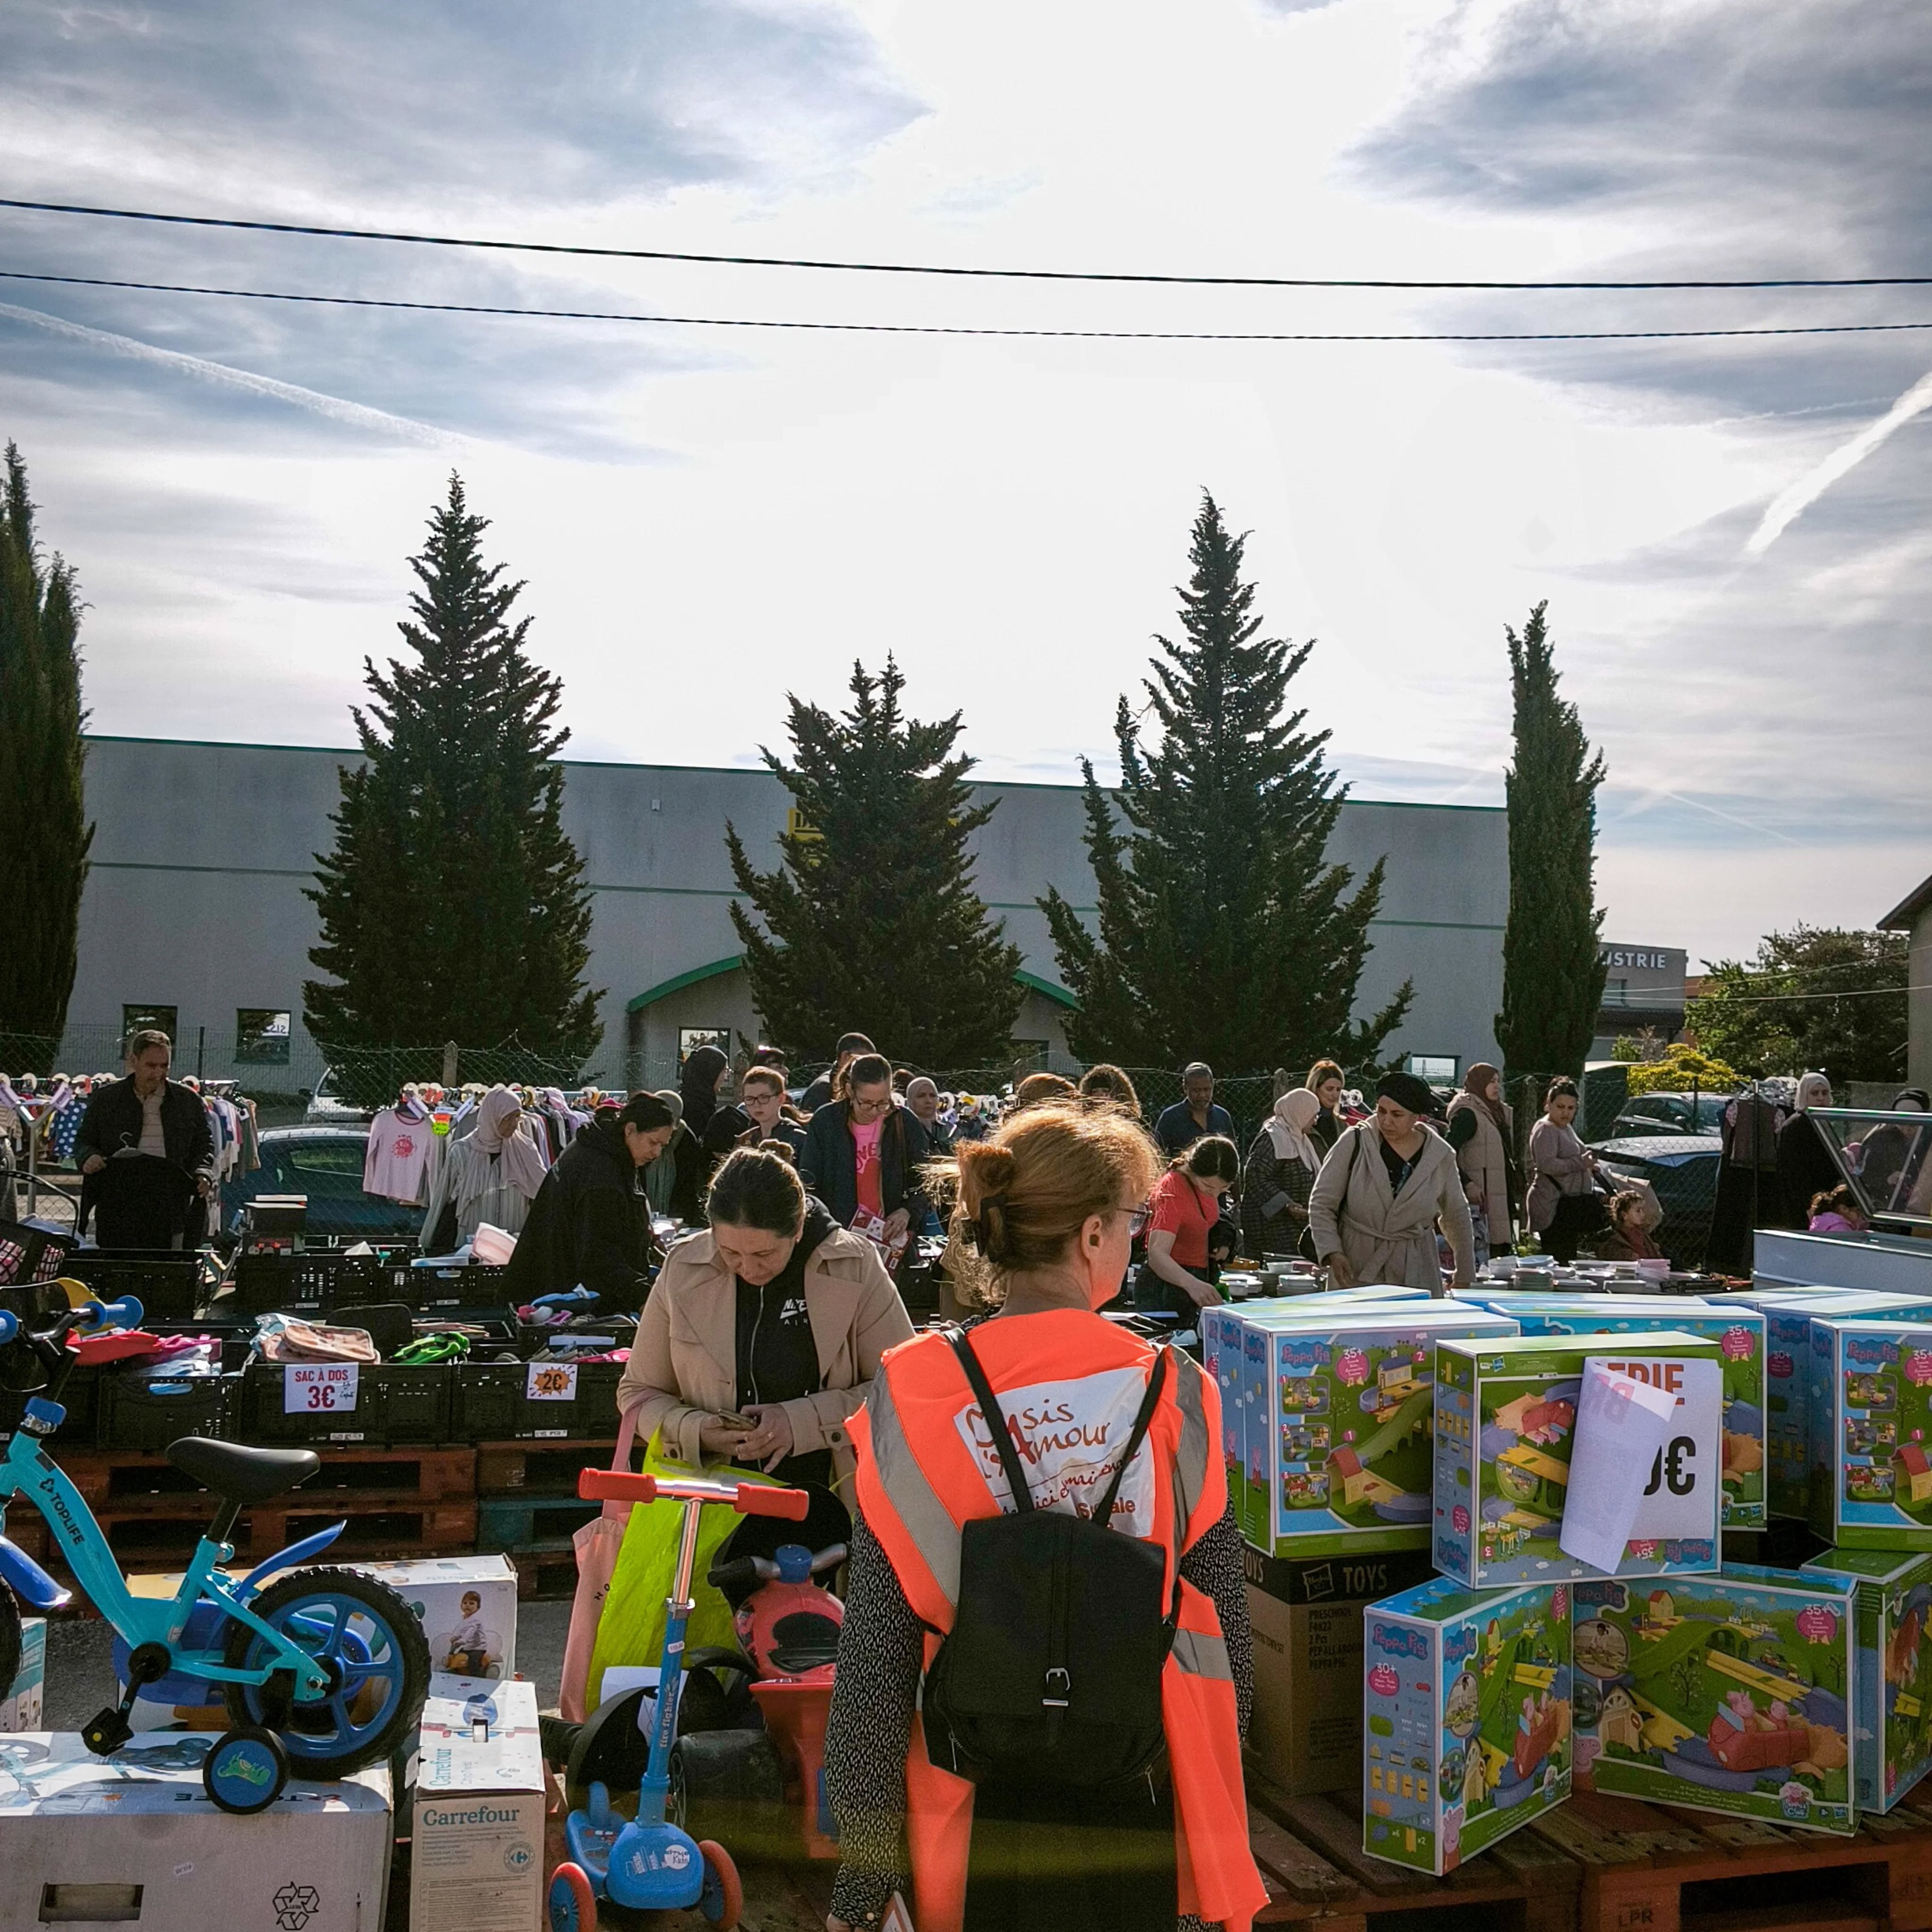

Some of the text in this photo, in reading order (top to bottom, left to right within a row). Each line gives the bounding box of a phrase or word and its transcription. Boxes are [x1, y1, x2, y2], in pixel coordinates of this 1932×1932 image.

[295, 1367, 348, 1382] SAC À DOS
[543, 1373, 562, 1390] 2€
[308, 1384, 335, 1408] 3€
[50, 1492, 85, 1545] TOPLIFE
[1343, 1564, 1388, 1593] TOYS
[430, 1748, 452, 1786] Carrefour
[423, 1806, 520, 1826] Carrefour
